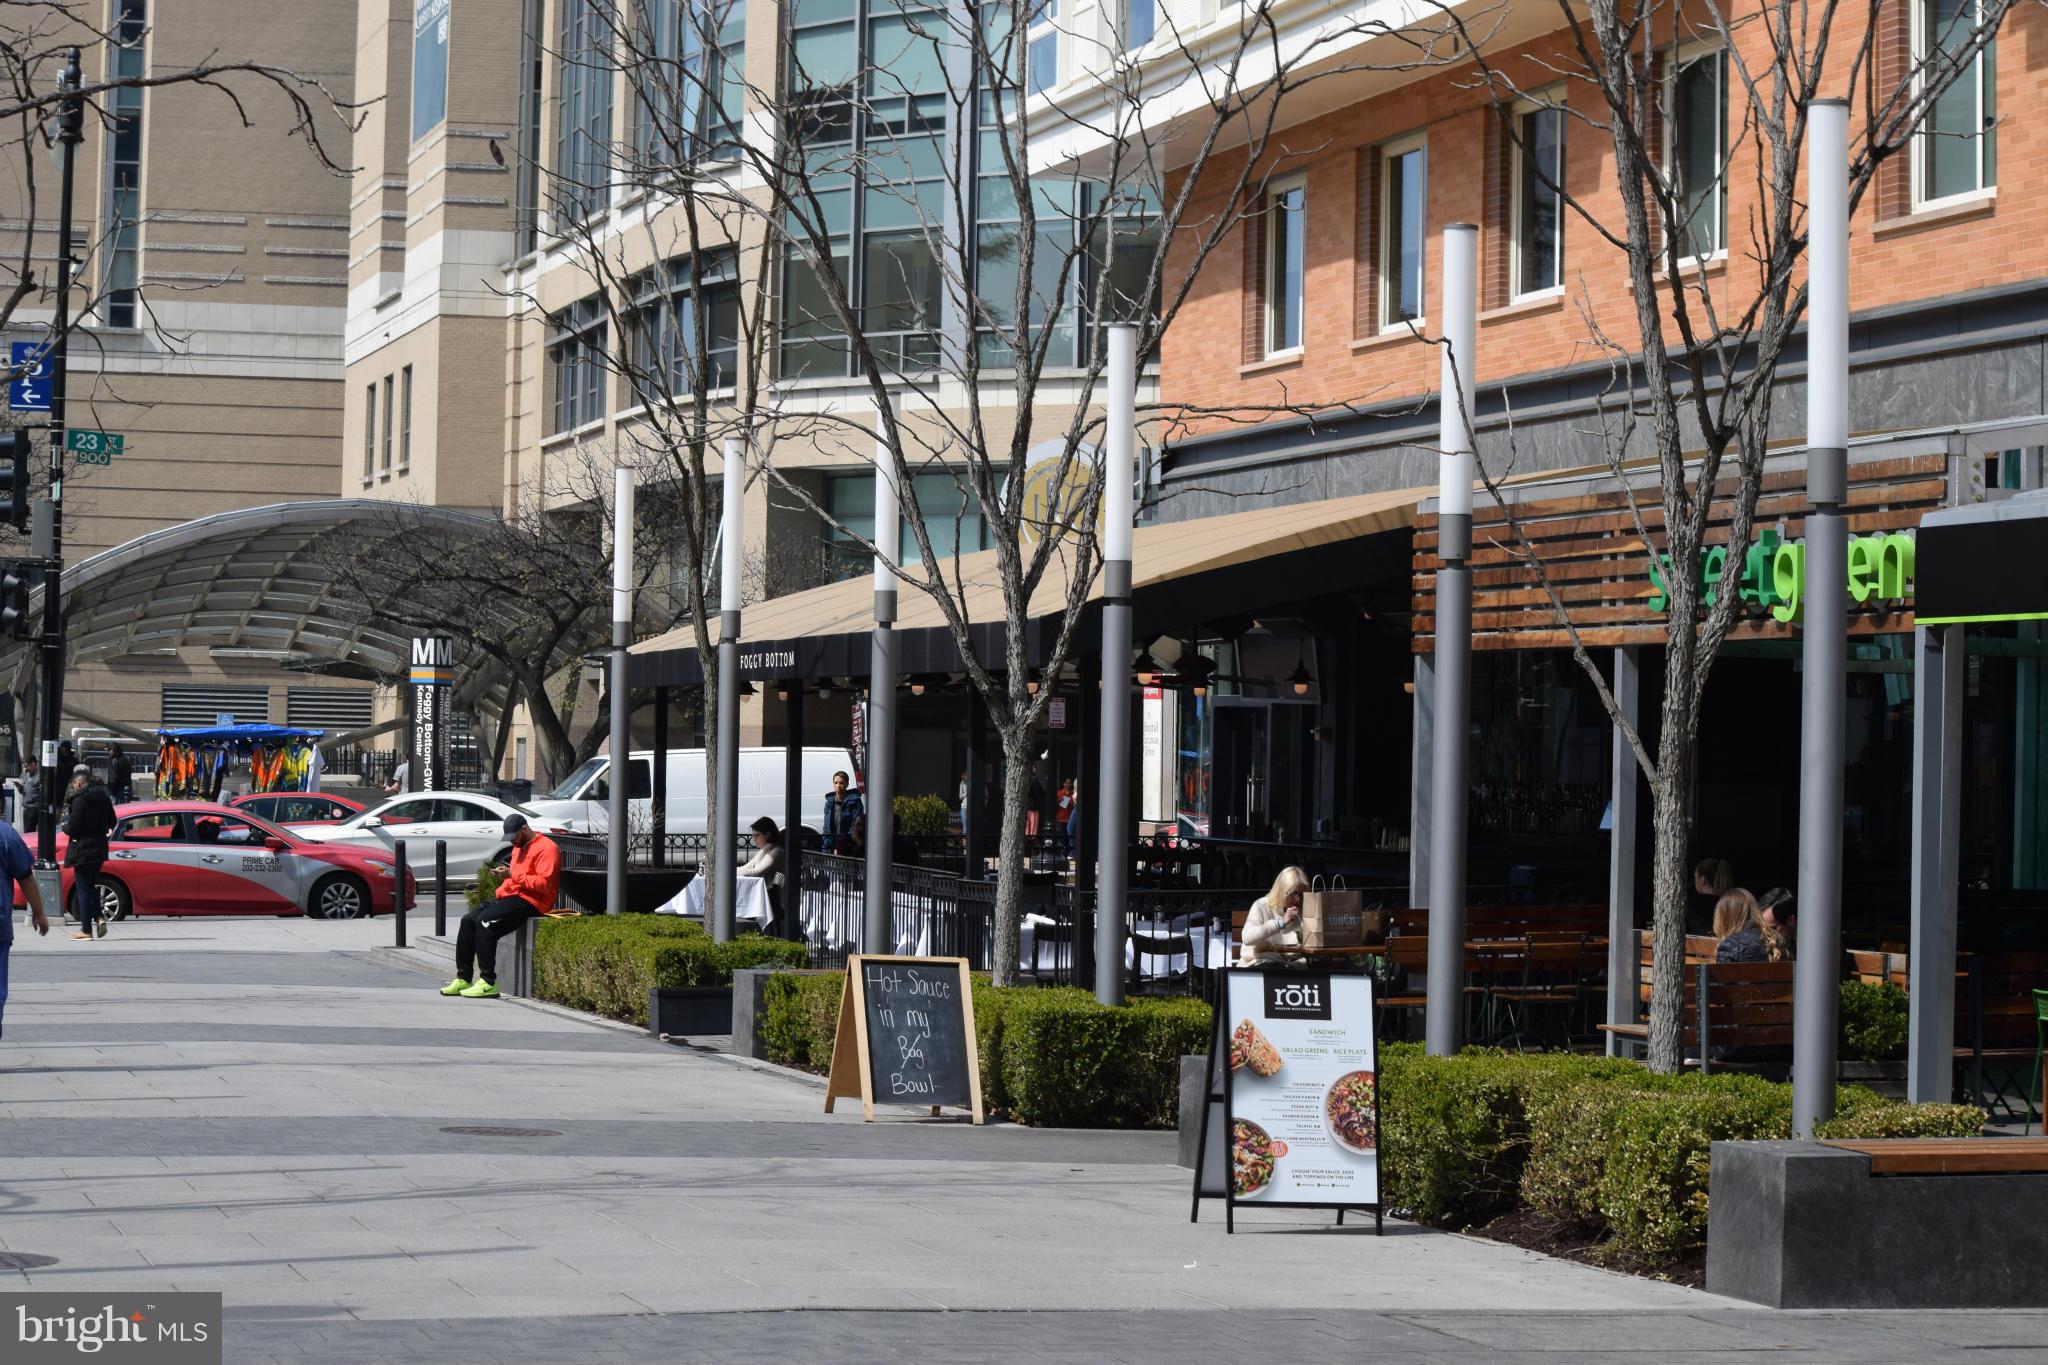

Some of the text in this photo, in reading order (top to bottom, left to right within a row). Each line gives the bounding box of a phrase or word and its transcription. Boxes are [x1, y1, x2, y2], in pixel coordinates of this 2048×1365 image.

[75, 433, 98, 450] 23
[79, 452, 108, 464] 900
[412, 637, 435, 665] M
[436, 638, 453, 665] M
[740, 651, 795, 669] FOGGY BOTTOM
[424, 685, 434, 721] Foggy
[415, 686, 424, 757] Kennedy Center
[444, 686, 452, 791] Foggy Bottom-GW
[242, 856, 280, 865] PRIME CAB
[866, 966, 950, 999] Hot Sauce
[877, 1003, 931, 1038] in my
[890, 1072, 936, 1095] Bowl
